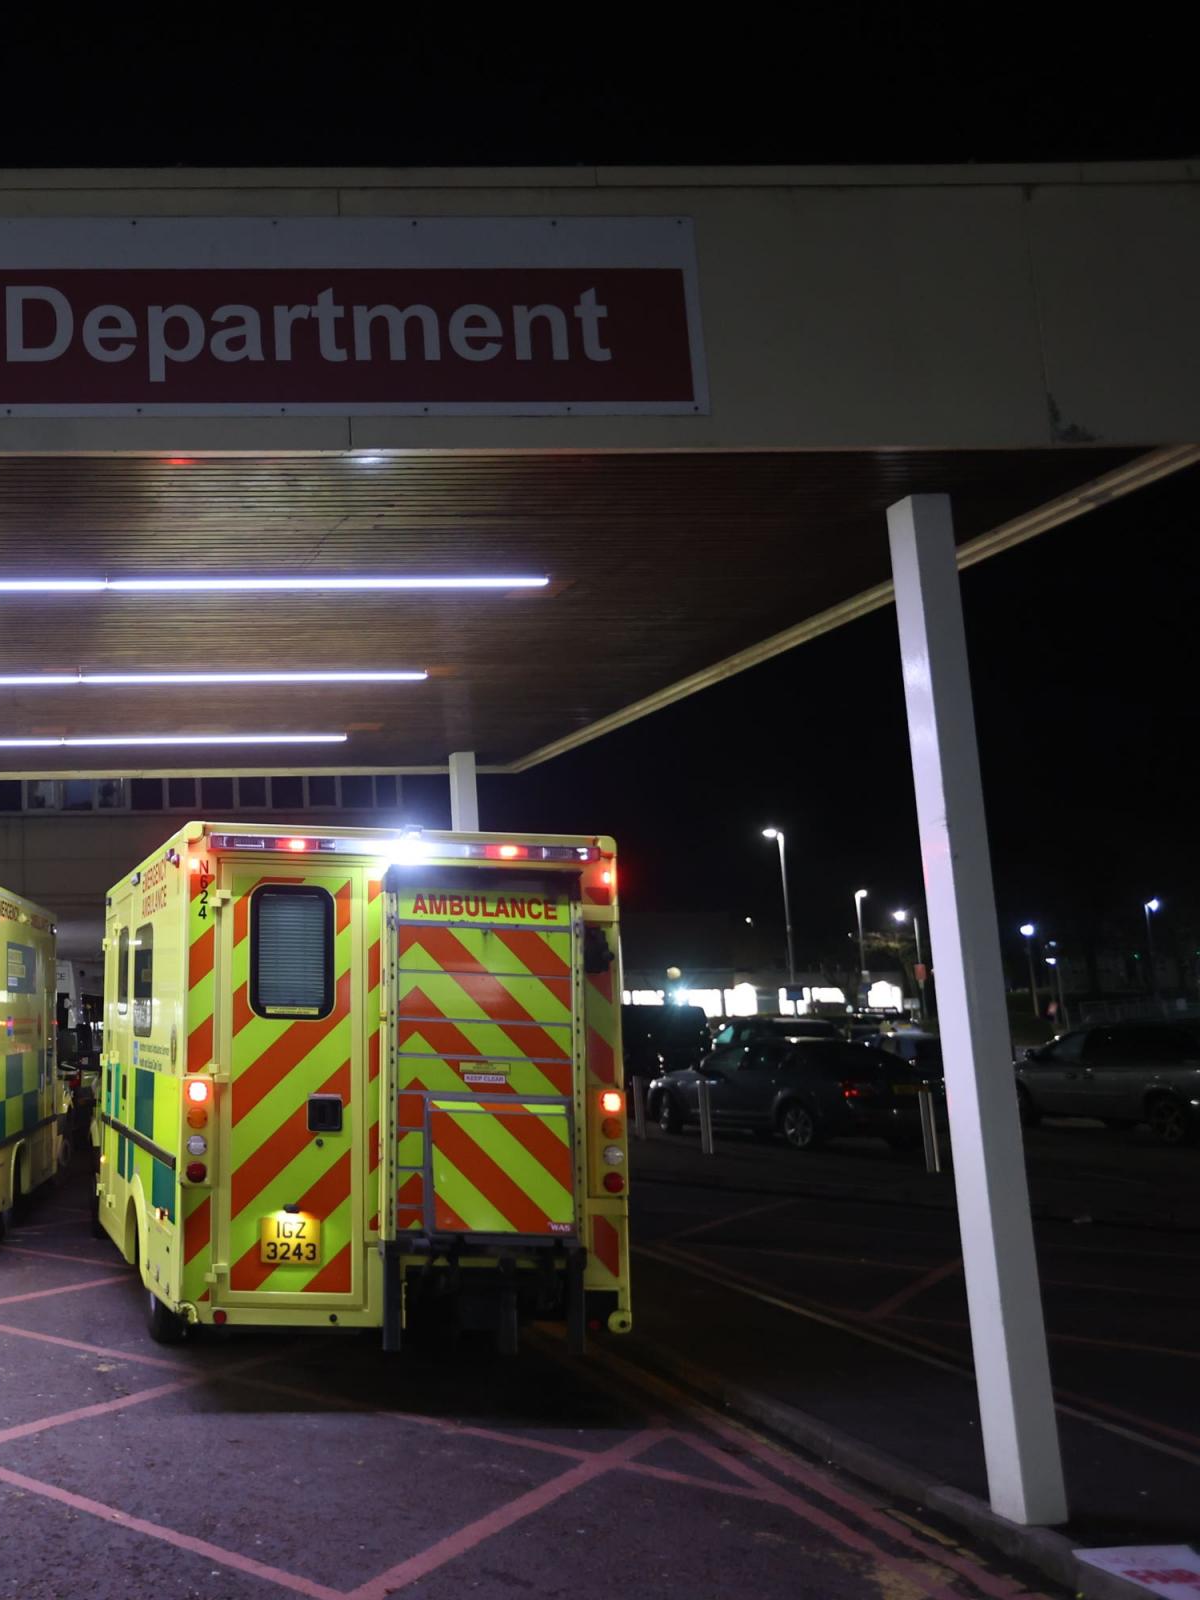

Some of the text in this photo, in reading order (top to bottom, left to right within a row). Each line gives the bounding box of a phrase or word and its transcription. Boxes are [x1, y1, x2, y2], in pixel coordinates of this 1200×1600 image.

[4, 284, 613, 382] Department
[412, 893, 558, 921] AMBULANCE
[276, 1221, 306, 1239] IGZ
[266, 1242, 317, 1261] 3243
